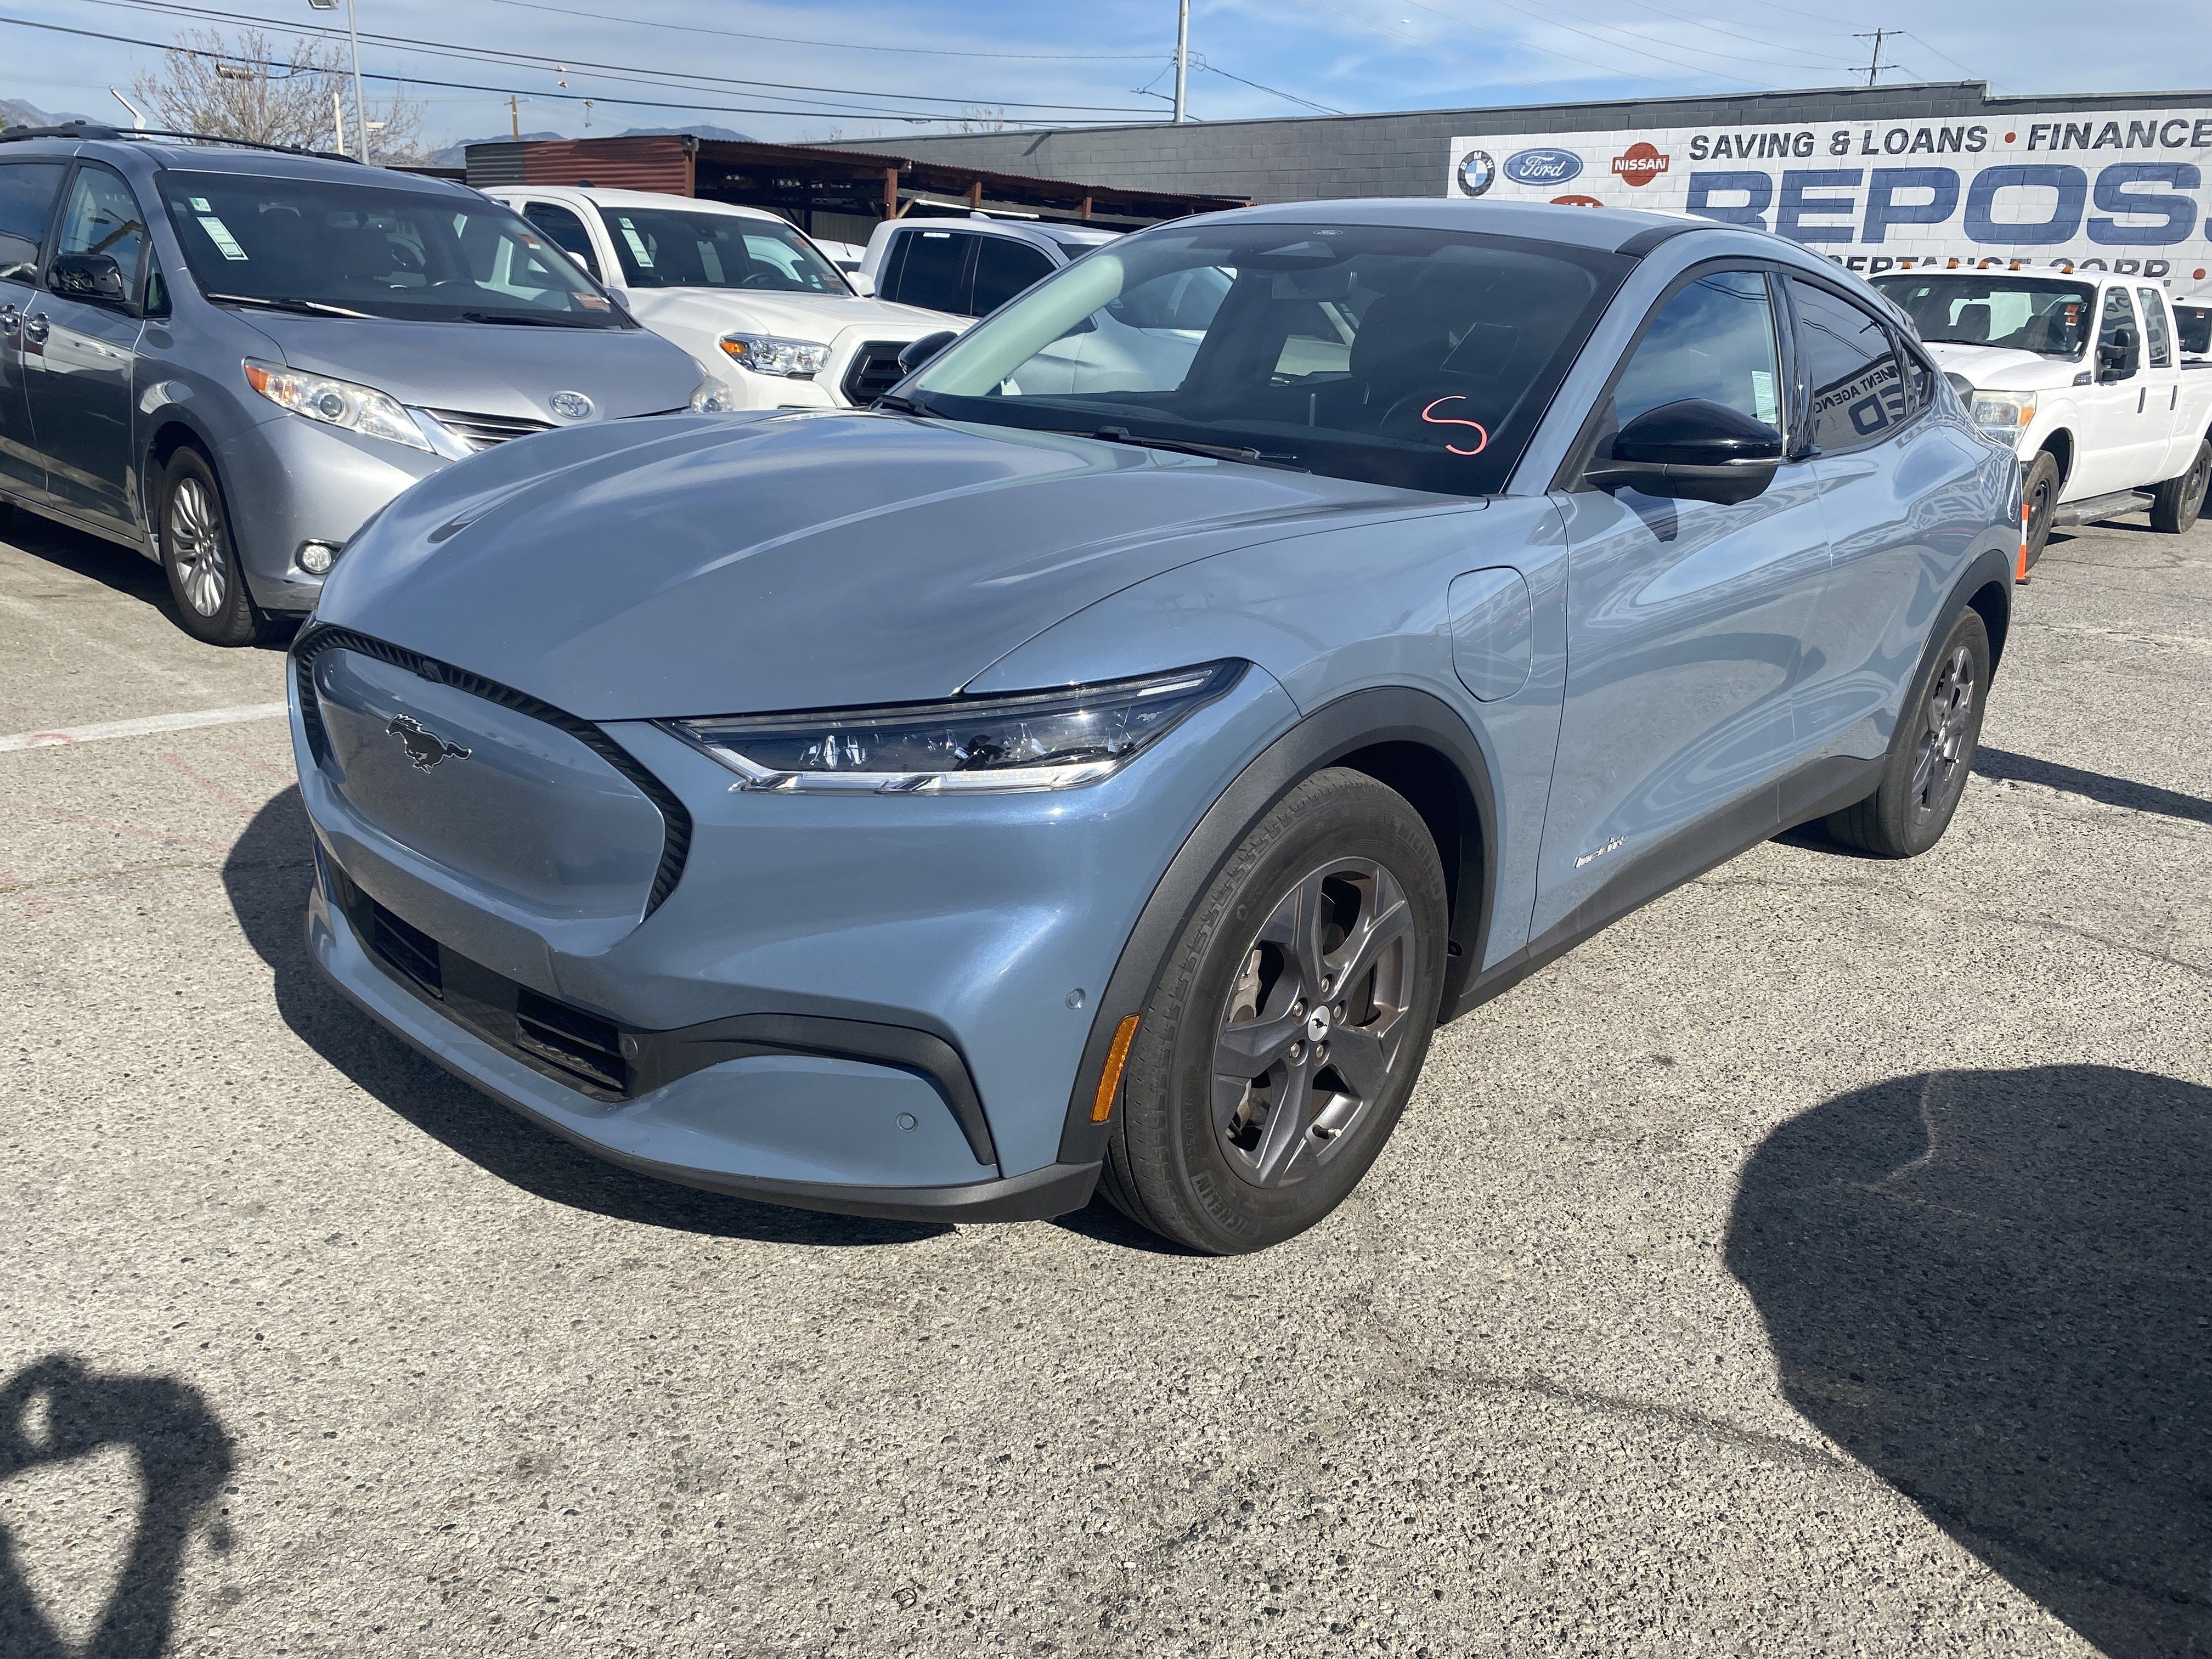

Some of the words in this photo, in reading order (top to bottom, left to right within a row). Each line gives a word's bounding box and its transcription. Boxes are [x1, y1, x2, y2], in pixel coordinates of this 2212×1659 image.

[1689, 131, 1815, 160] SAVING
[1829, 131, 1850, 156] &
[1861, 125, 1988, 155] LOANS
[2027, 119, 2212, 151] FINANCE
[1520, 156, 1566, 177] Ford
[1615, 158, 1666, 171] NISSAN
[1685, 162, 2212, 246] REPOS
[1421, 395, 1487, 455] S
